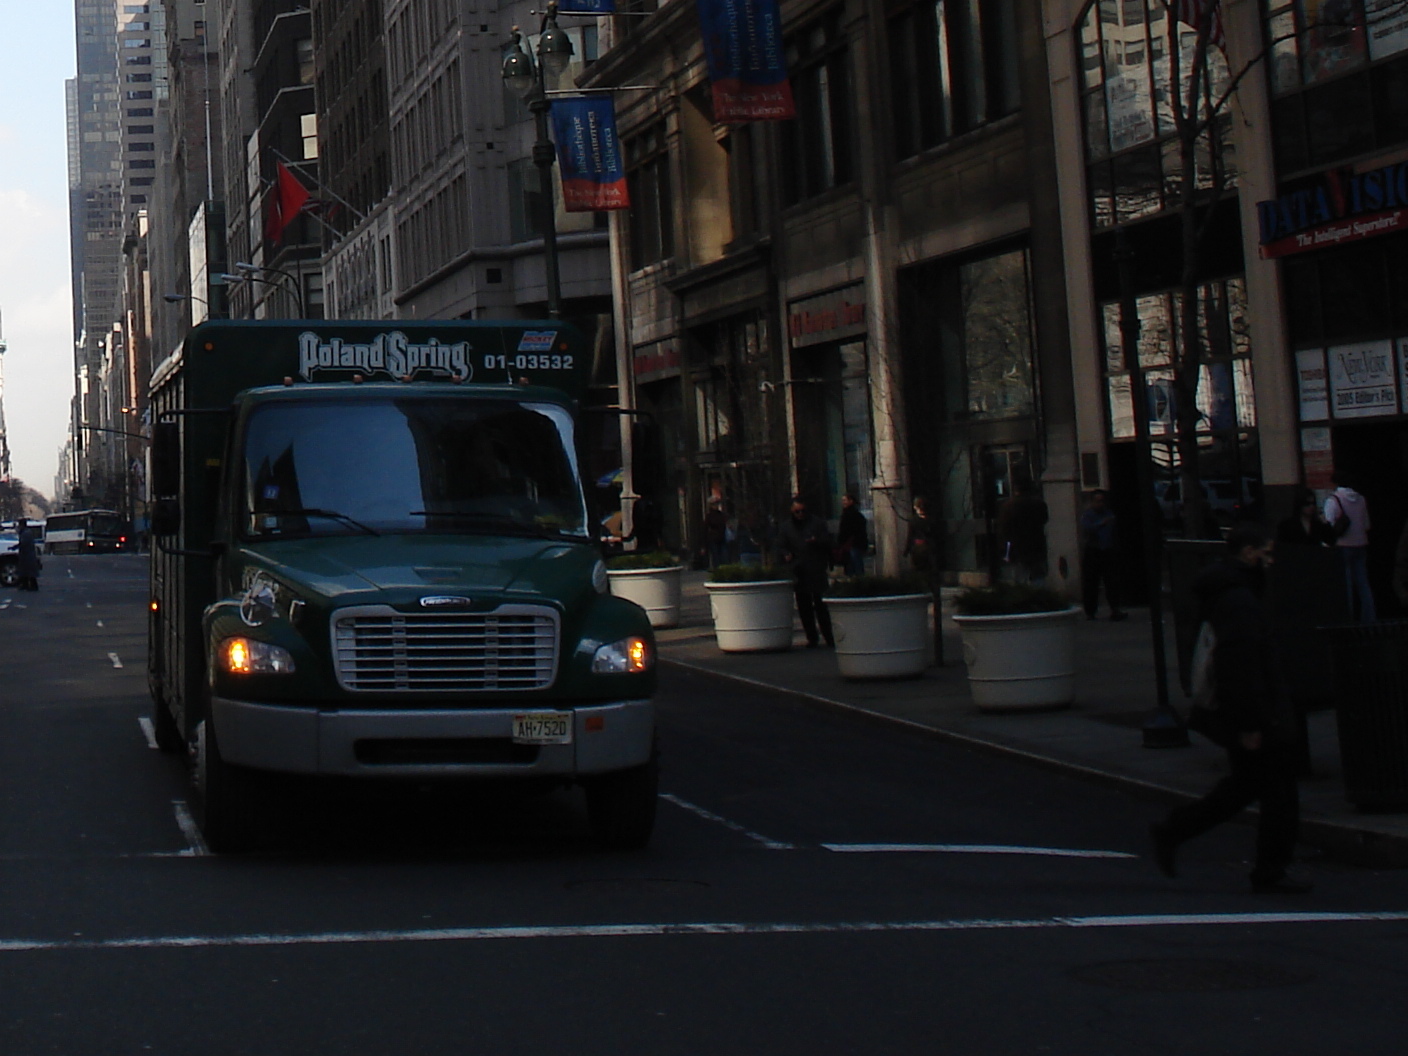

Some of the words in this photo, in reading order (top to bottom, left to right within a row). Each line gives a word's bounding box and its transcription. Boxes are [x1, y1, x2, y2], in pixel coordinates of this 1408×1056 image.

[299, 331, 387, 382] Poland
[387, 331, 473, 382] Spring
[483, 354, 574, 370] 01-03532
